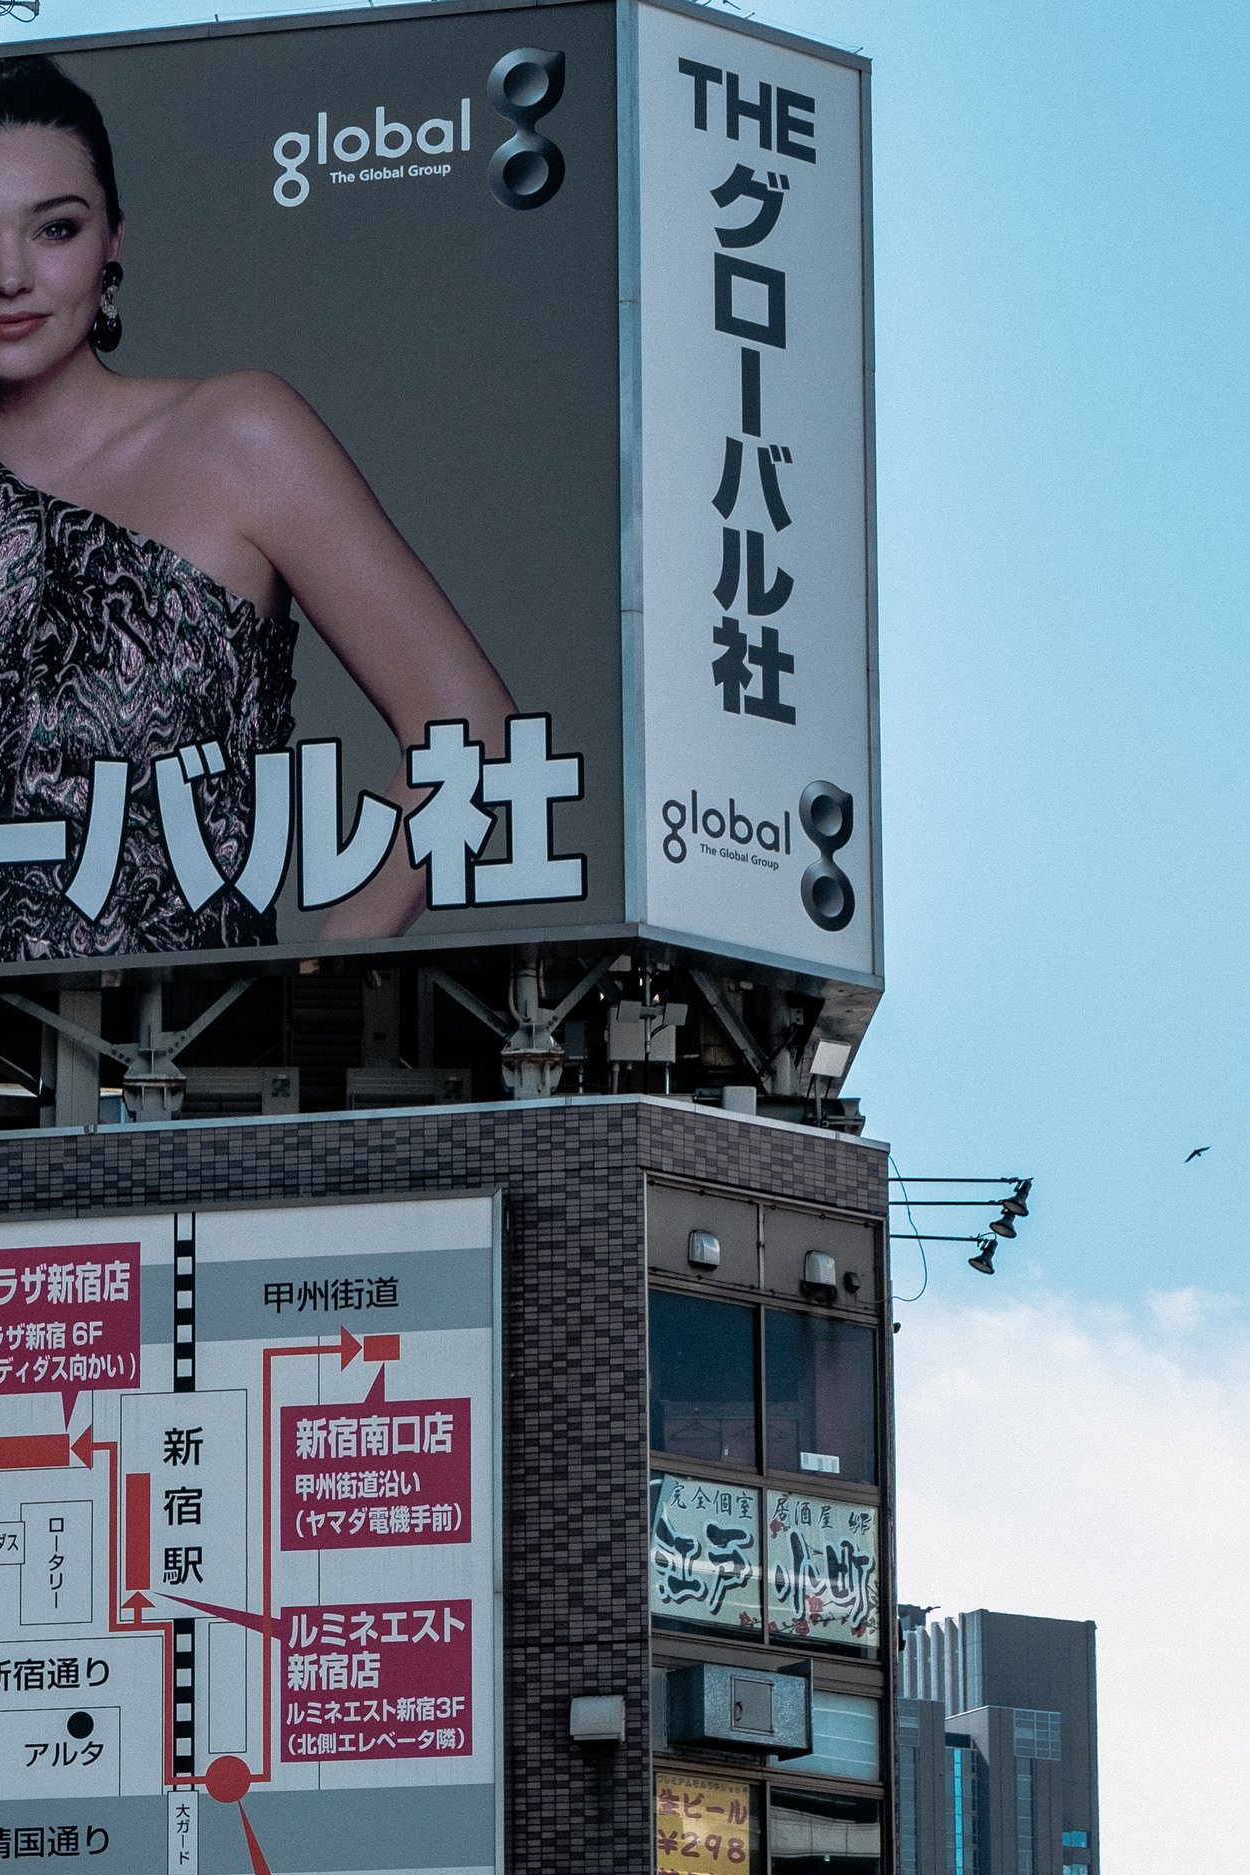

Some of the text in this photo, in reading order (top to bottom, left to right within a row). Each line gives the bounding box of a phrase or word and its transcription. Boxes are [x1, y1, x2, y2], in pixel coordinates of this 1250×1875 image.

[679, 58, 817, 165] THE
[273, 98, 470, 207] global
[330, 164, 451, 184] The Global Group
[710, 164, 797, 725] グローバル社
[662, 789, 791, 865] global
[700, 843, 779, 872] The Global Group
[263, 1276, 400, 1312] 甲州街道
[72, 1321, 103, 1346] 6F
[296, 1411, 454, 1460] 新宿南口店
[295, 1469, 421, 1501] 甲州街道沿い
[162, 1426, 205, 1586] 新宿駅
[295, 1502, 462, 1538] (ヤマダ電機手前)
[770, 1495, 833, 1530] 居酒屋
[48, 1517, 64, 1610] ロータリー
[288, 1607, 466, 1649] ルミネエスト
[287, 1650, 381, 1691] 新宿店
[286, 1696, 465, 1725] ルミネエスト新宿3F
[24, 1740, 103, 1768] アルタ
[288, 1727, 465, 1756] (北側エレベータ隣)
[658, 1788, 748, 1825] 生ビール
[175, 1801, 191, 1867] 大ガード
[657, 1829, 747, 1864] ¥298
